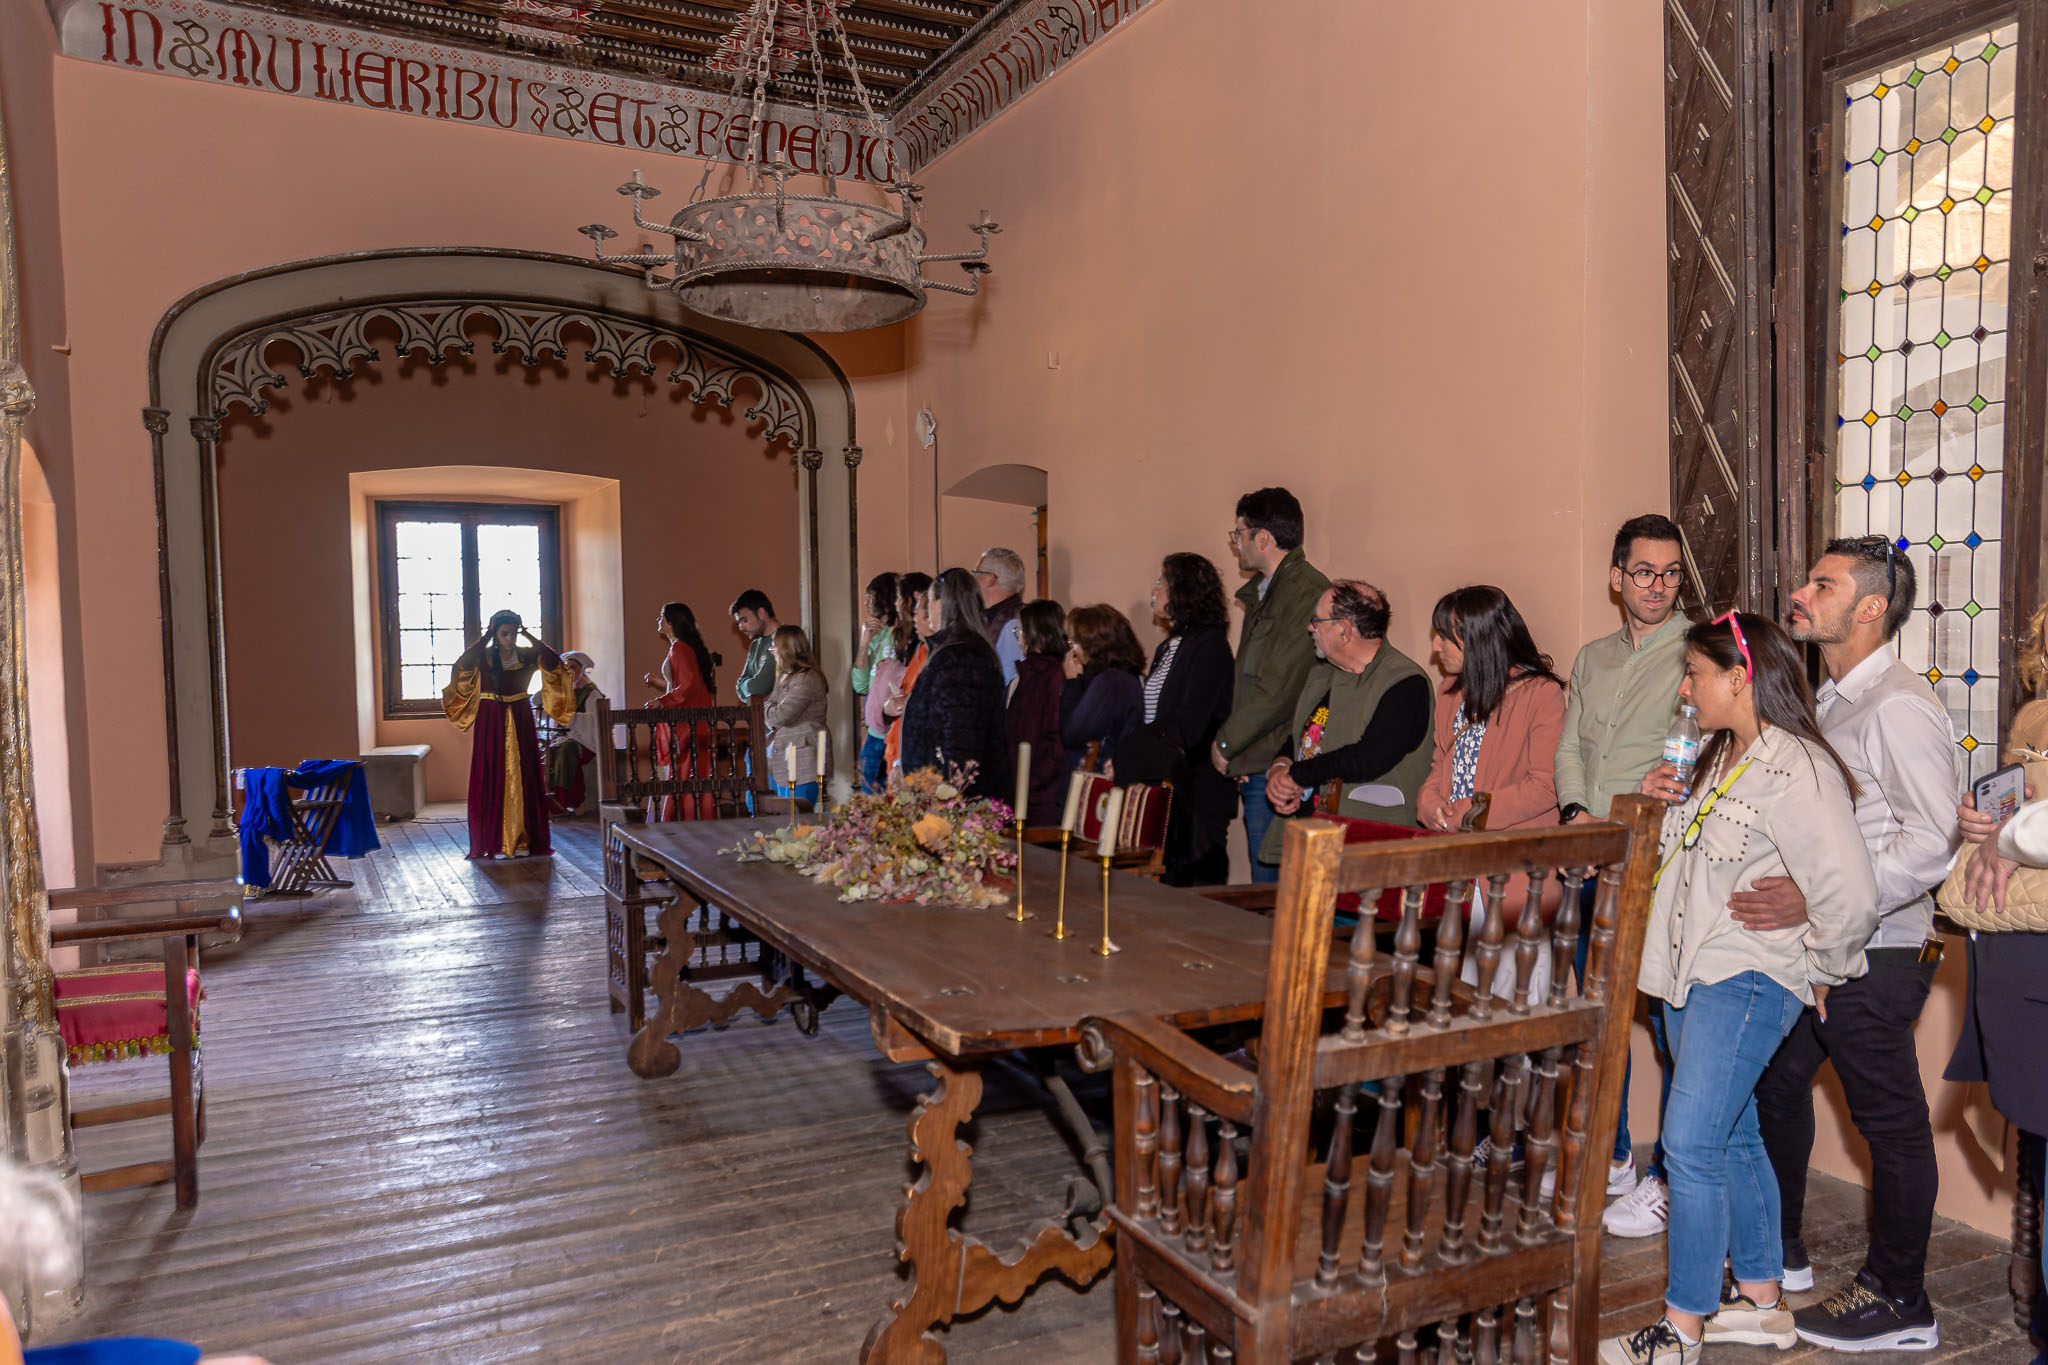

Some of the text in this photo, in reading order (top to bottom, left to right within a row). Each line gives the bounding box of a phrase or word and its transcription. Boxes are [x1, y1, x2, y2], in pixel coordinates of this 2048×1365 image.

[98, 1, 165, 70] IN
[216, 28, 550, 132] MULIERIBUS
[589, 92, 656, 149] ET
